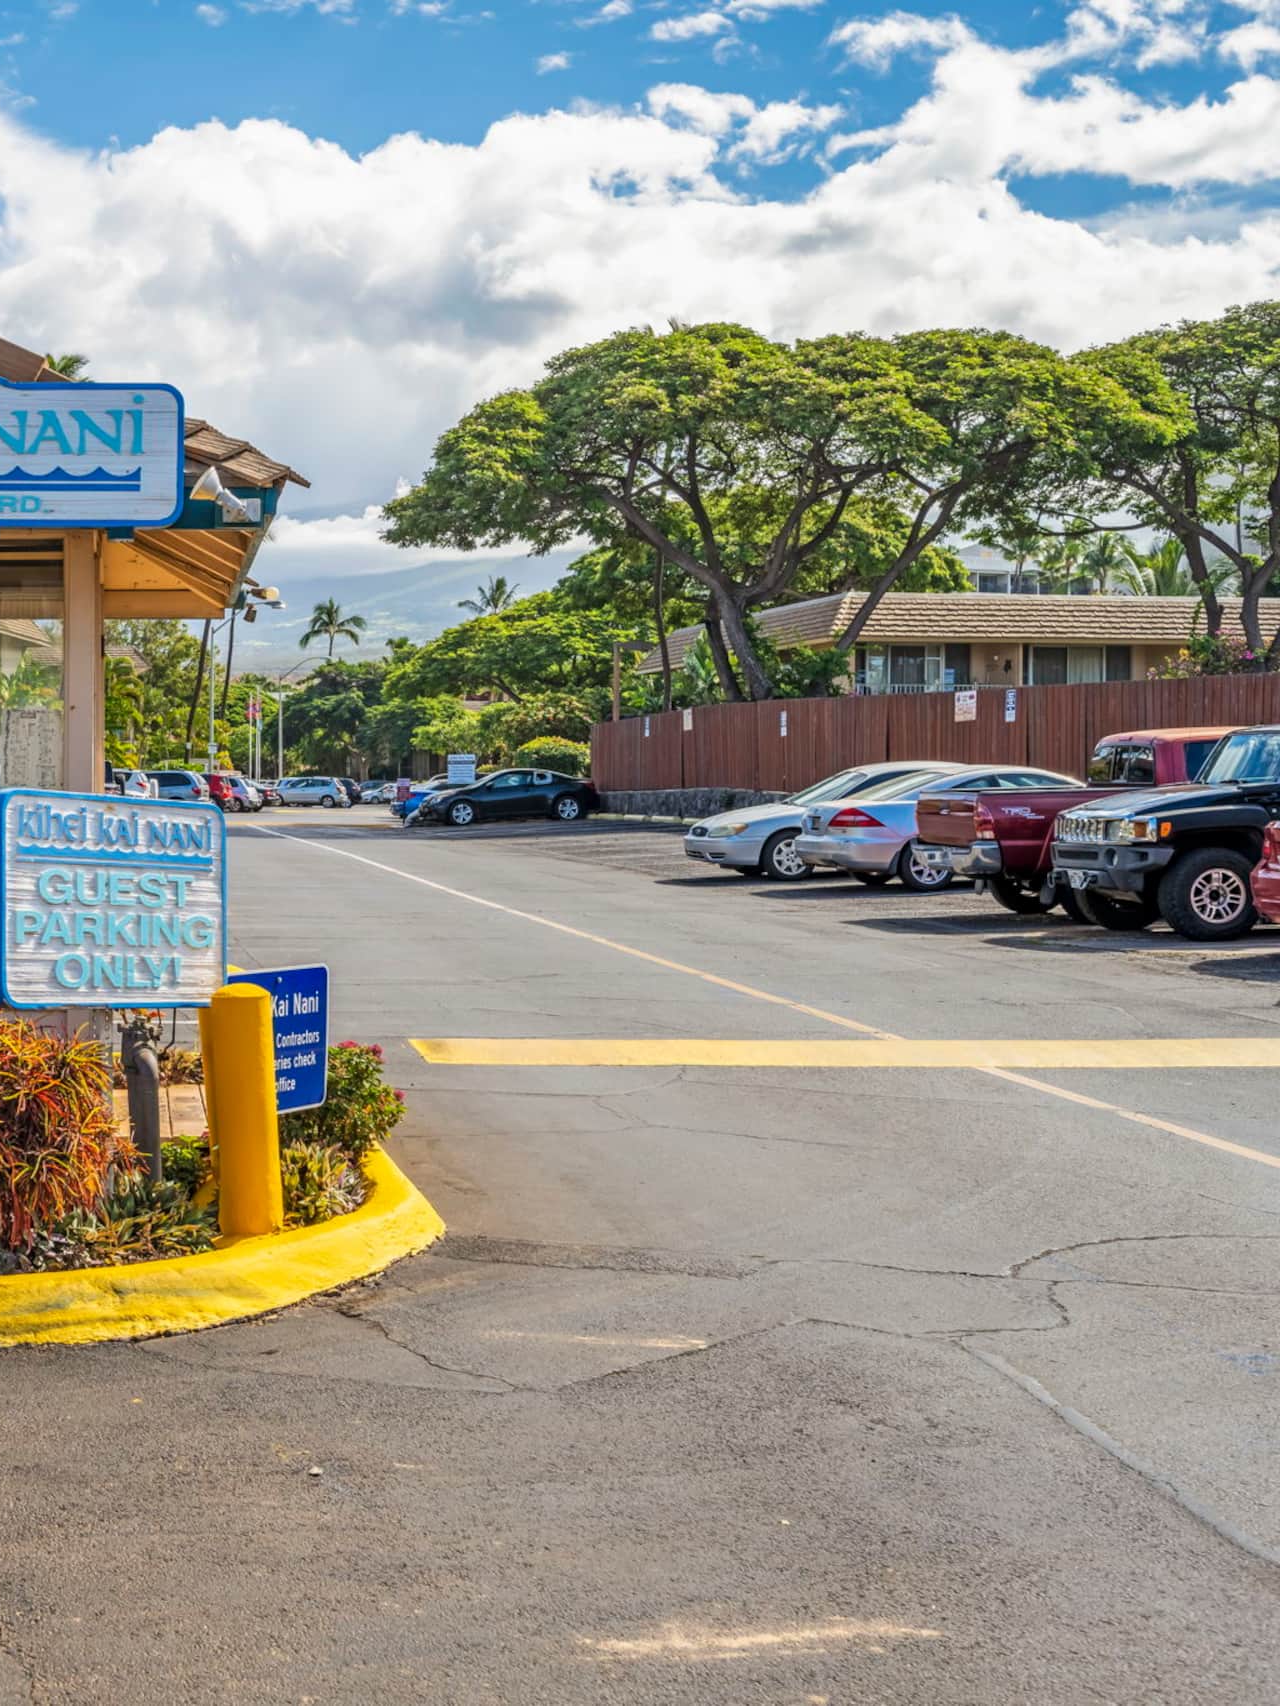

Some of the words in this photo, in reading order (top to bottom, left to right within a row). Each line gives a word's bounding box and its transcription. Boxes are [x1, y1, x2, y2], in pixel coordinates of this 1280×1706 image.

[39, 868, 194, 908] GUEST
[15, 910, 216, 949] PARKING
[55, 953, 182, 989] ONLY!
[293, 990, 319, 1015] Nani
[276, 1030, 320, 1048] Contractors
[293, 1050, 317, 1068] check
